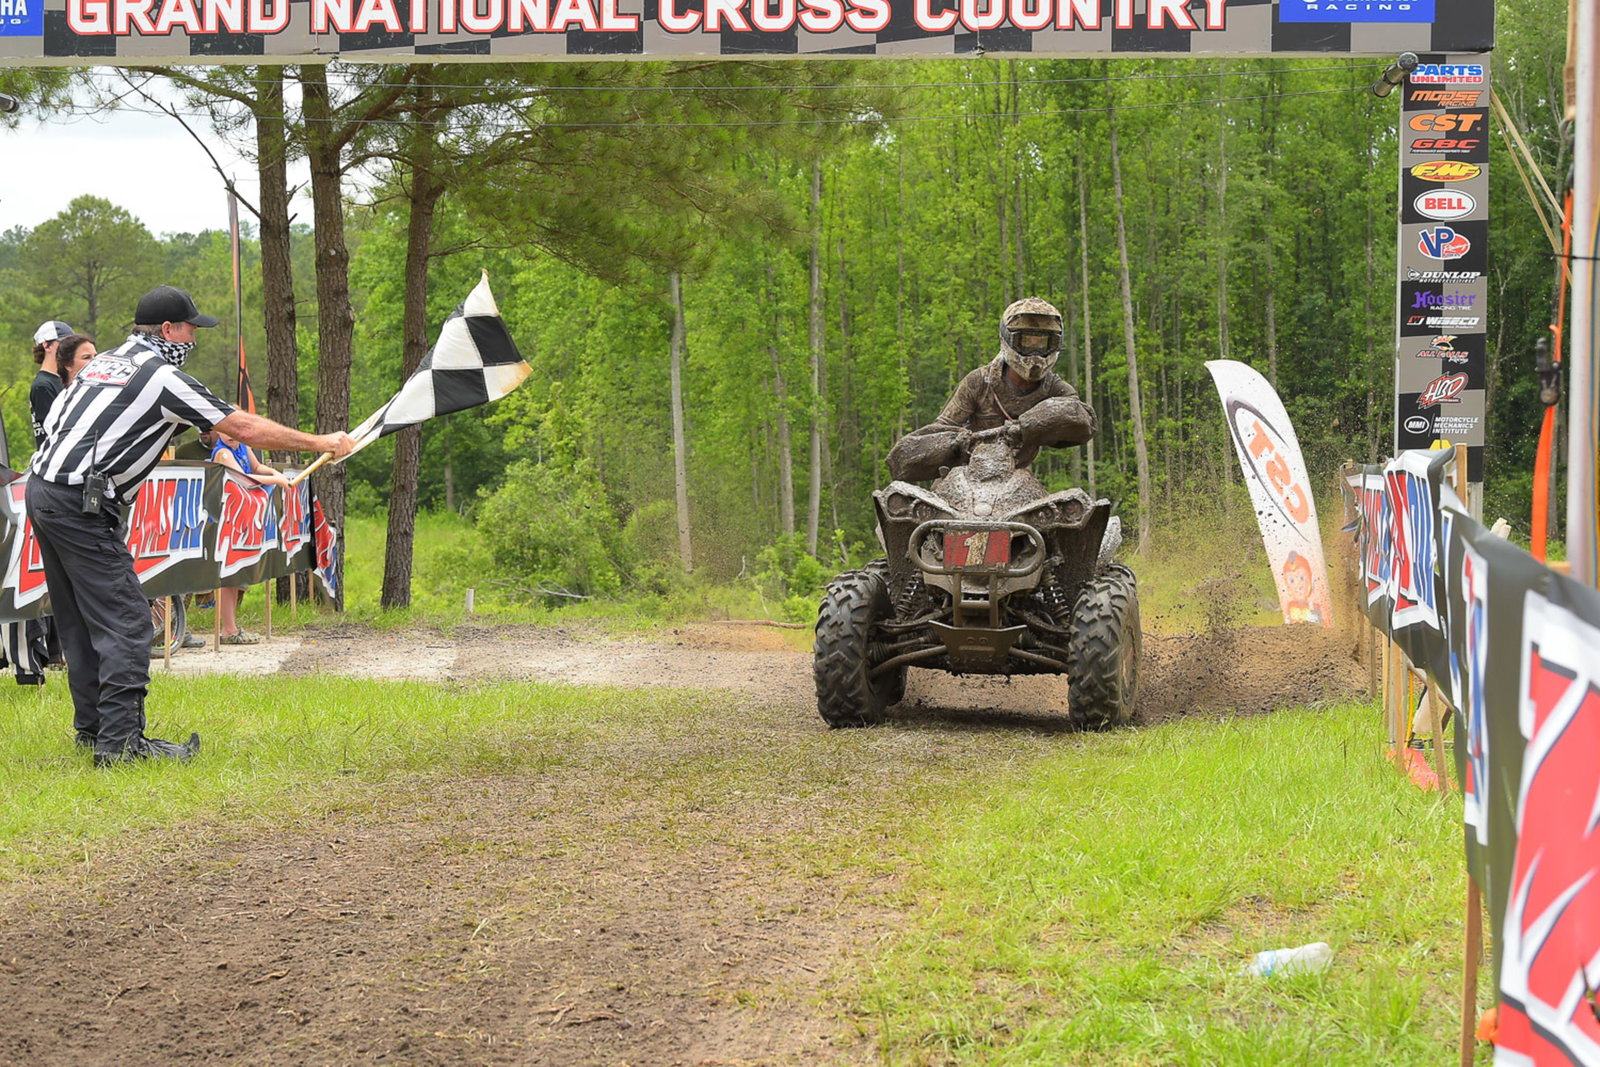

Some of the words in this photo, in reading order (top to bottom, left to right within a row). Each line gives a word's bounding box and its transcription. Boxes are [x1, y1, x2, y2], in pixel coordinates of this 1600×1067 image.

[66, 0, 290, 35] GRAND
[311, 0, 640, 34] NATIONAL
[658, 0, 892, 33] CROSS
[913, 0, 1227, 32] COUNTRY
[1410, 64, 1483, 76] PARTS
[1410, 90, 1483, 101] MOOSE
[1411, 139, 1480, 149] GBC
[1411, 163, 1480, 176] FMF
[1425, 198, 1467, 210] BELL
[1420, 228, 1455, 258] VP
[1421, 271, 1481, 279] DUNLOP
[1411, 291, 1476, 308] Hoosier
[1407, 421, 1426, 429] MMI
[1248, 420, 1310, 524] CST
[91, 497, 99, 507] 4
[963, 532, 990, 566] 1
